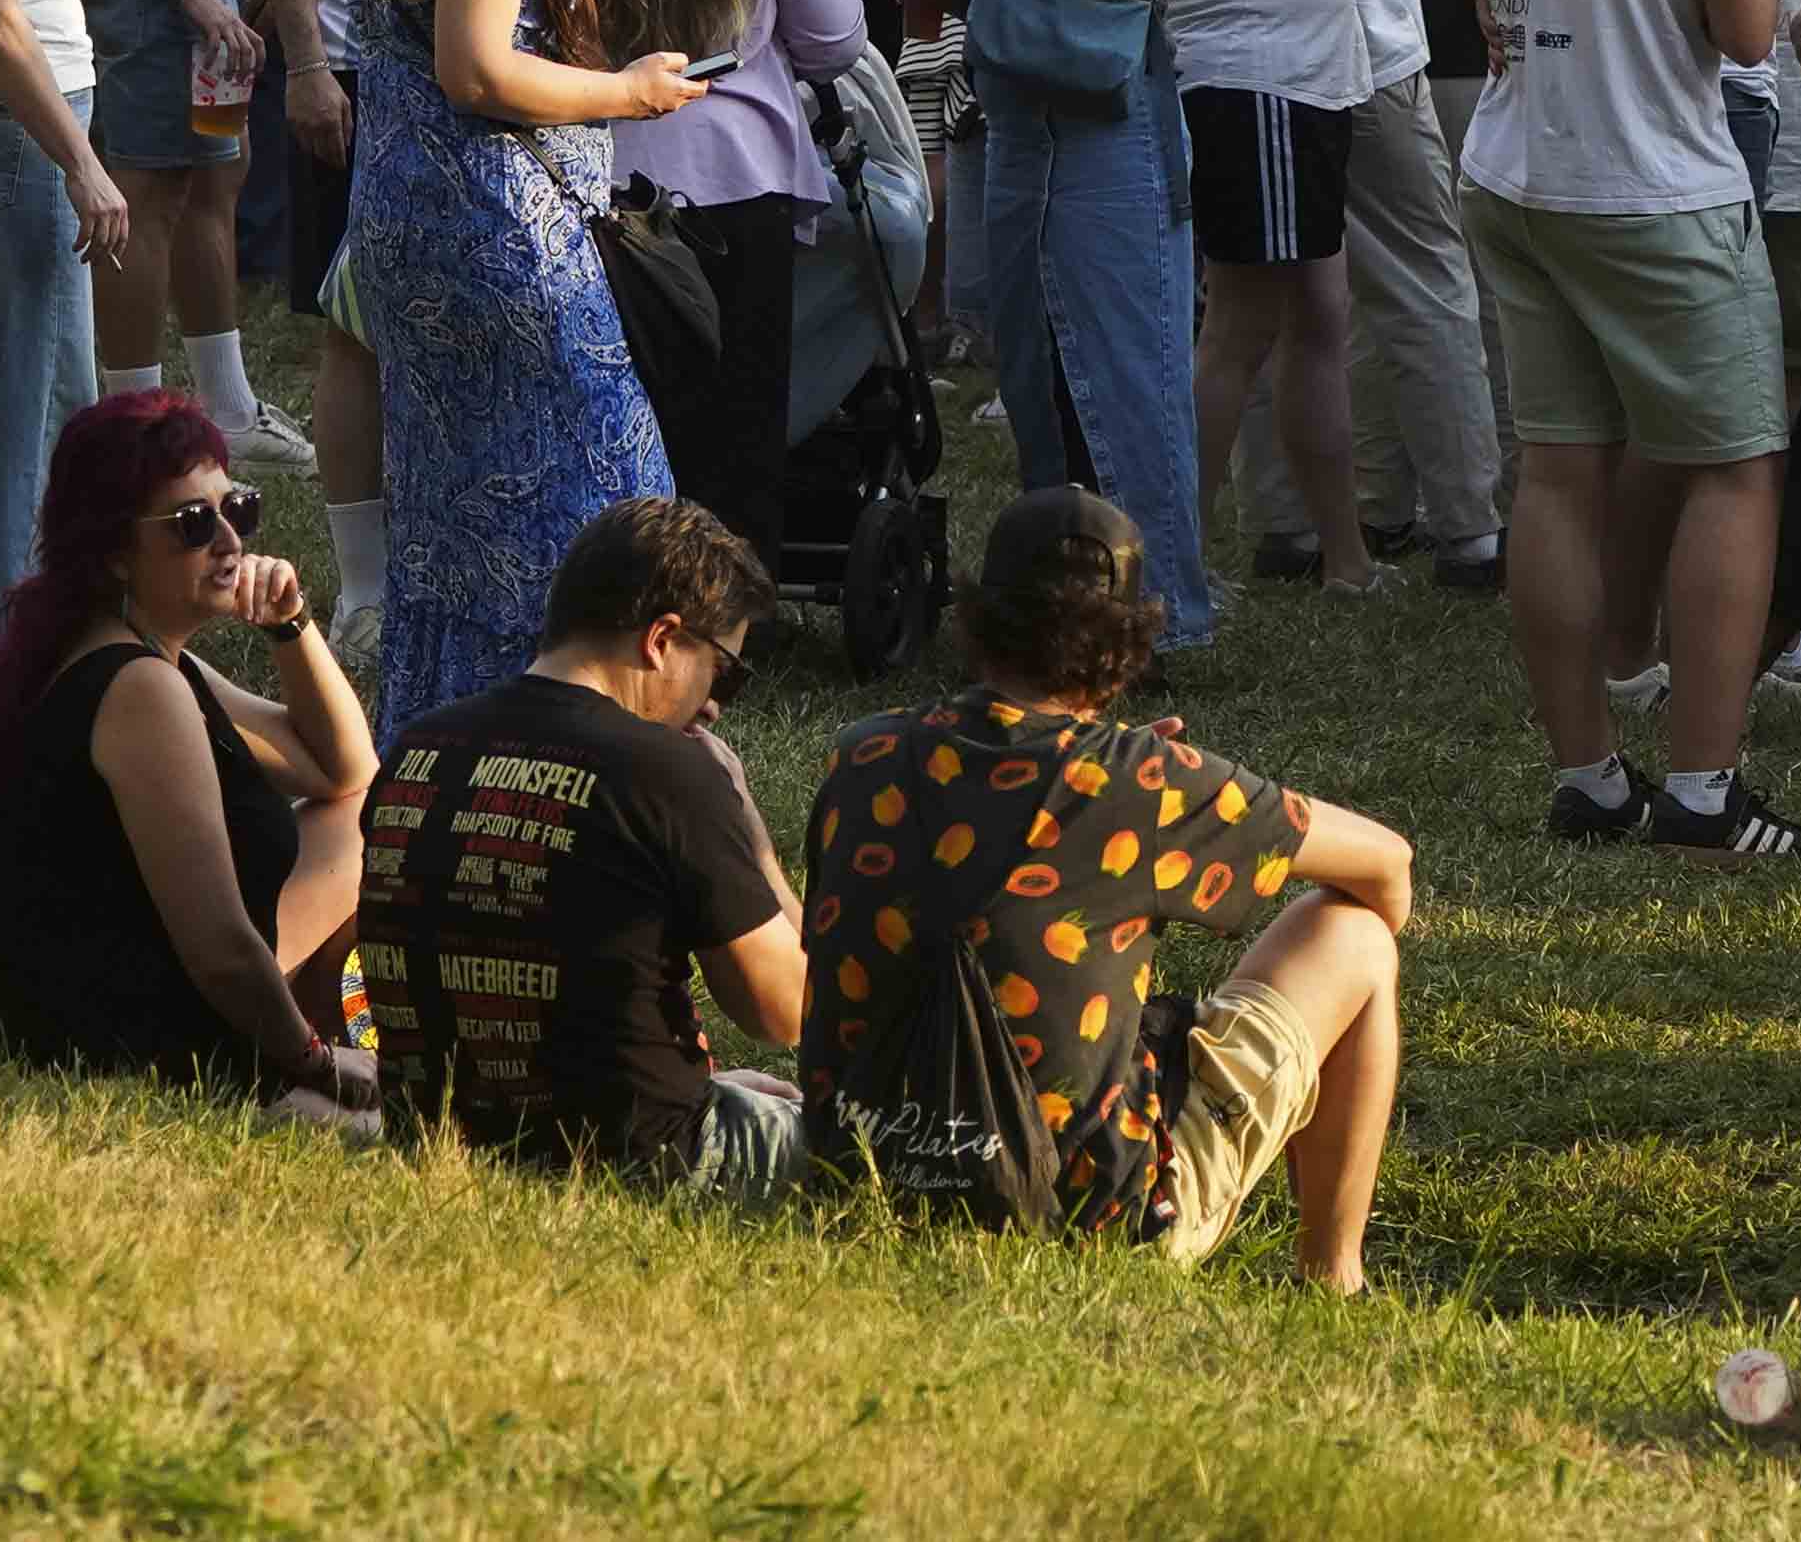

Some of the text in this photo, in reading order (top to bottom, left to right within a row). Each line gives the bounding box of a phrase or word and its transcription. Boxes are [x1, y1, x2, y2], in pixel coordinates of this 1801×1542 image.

[468, 755, 598, 809] MOONSPELL
[450, 810, 521, 841] RHAPSODY
[521, 819, 542, 843] OF
[541, 825, 577, 854] FIRE
[439, 953, 559, 1002] HATEBREED
[873, 1101, 1003, 1162] Pilates
